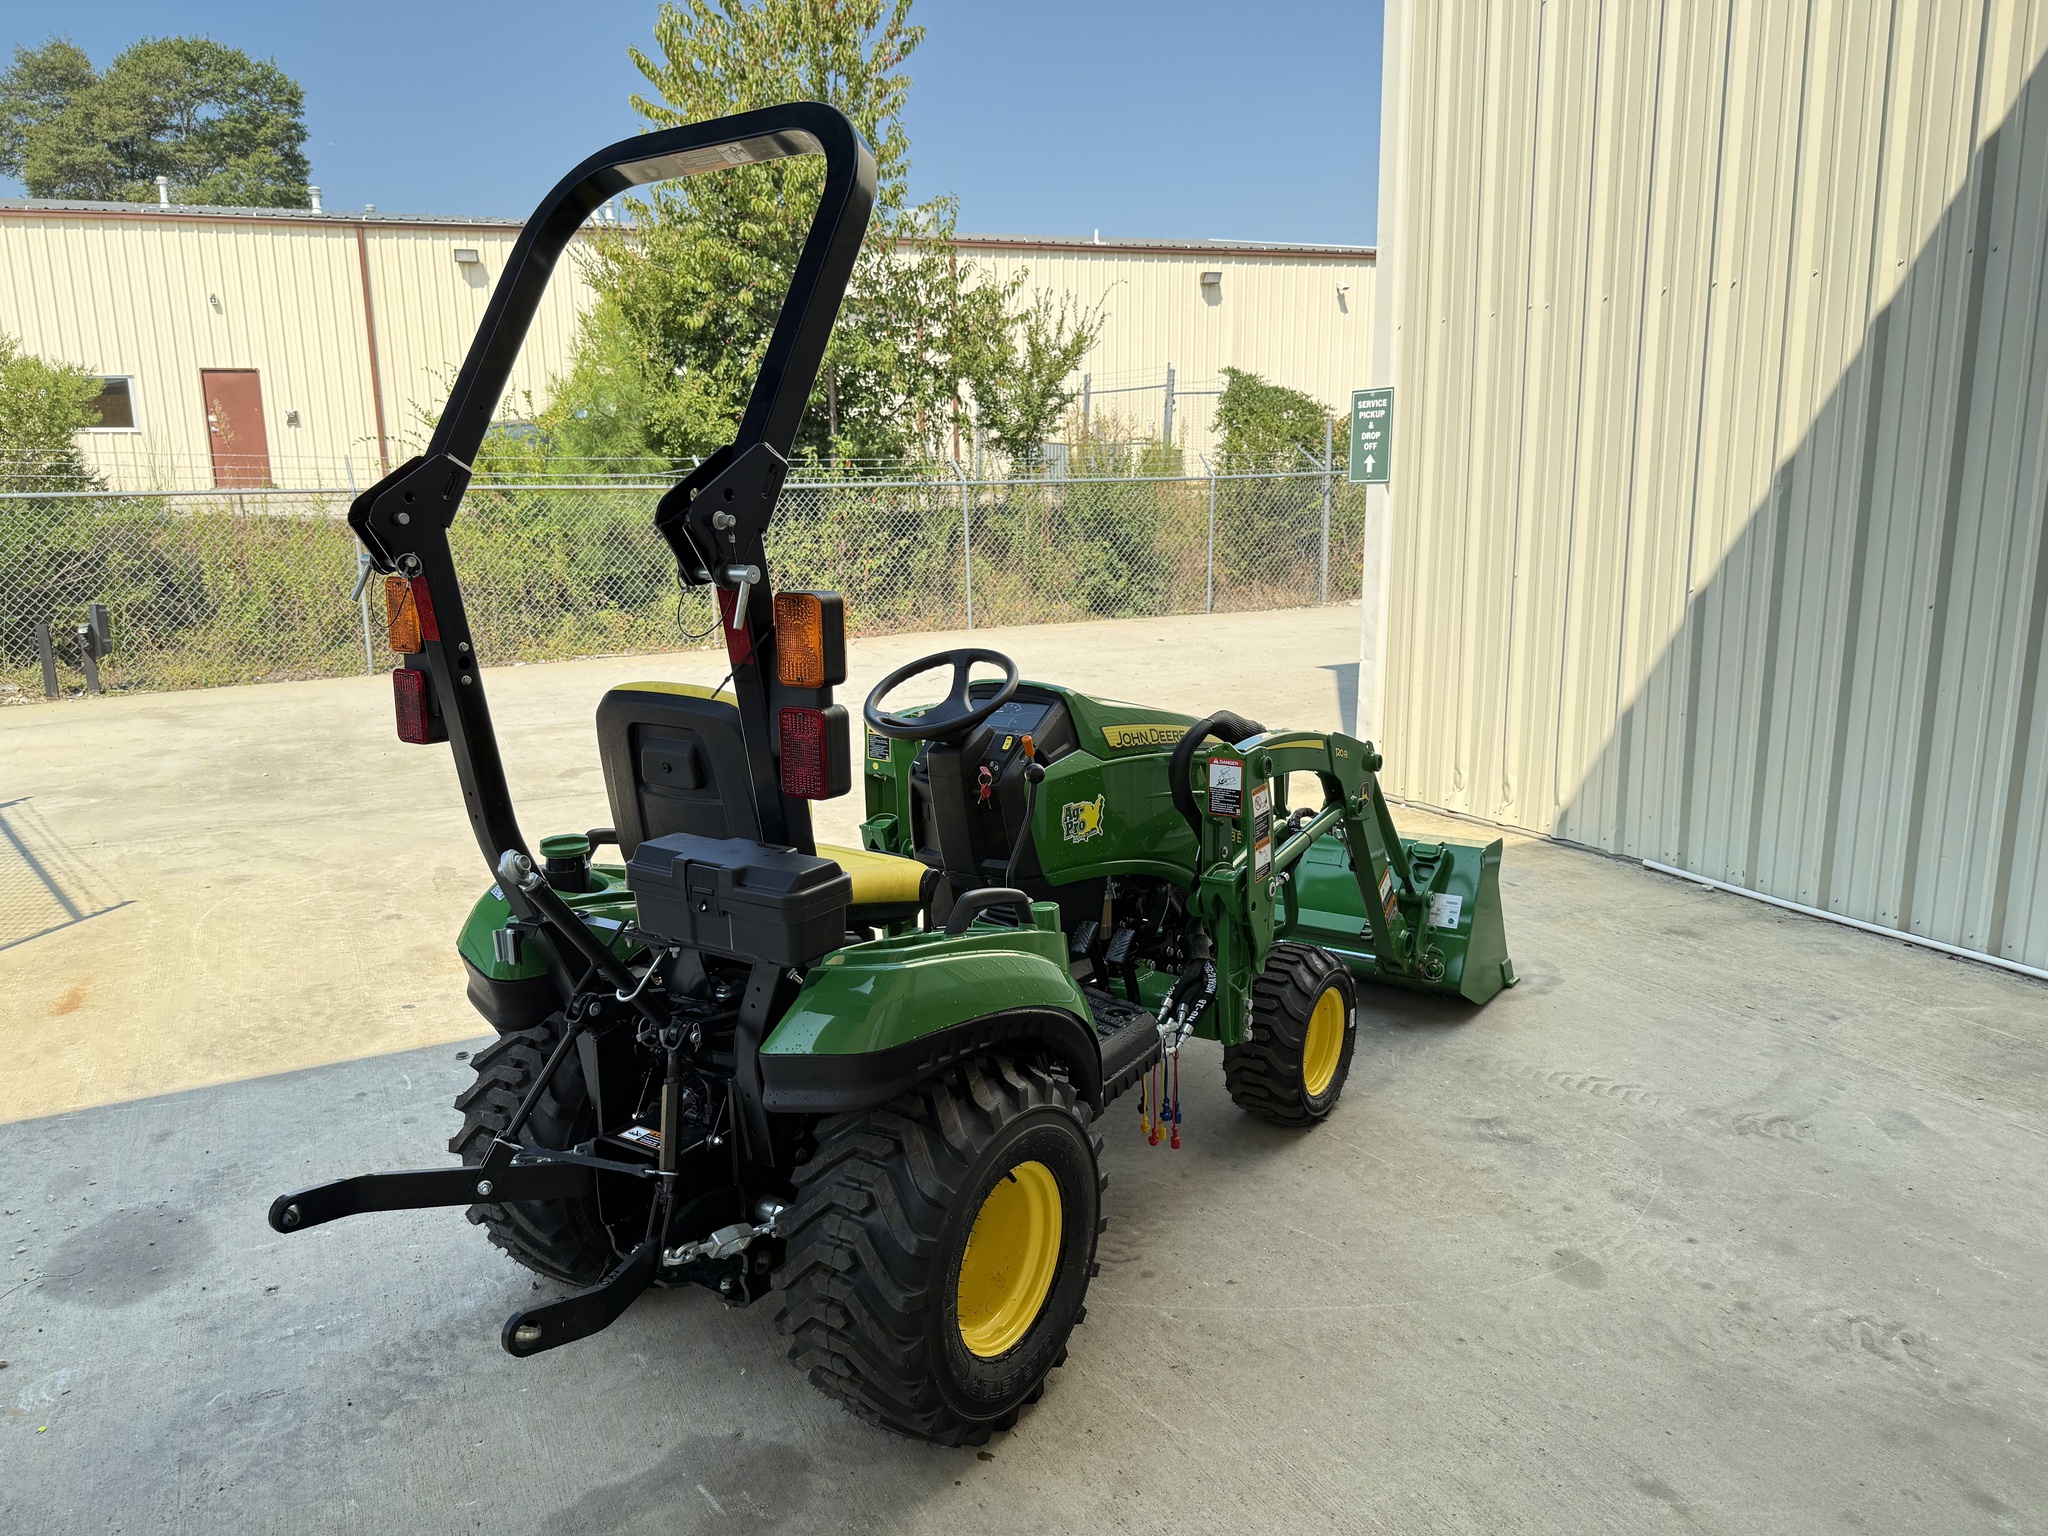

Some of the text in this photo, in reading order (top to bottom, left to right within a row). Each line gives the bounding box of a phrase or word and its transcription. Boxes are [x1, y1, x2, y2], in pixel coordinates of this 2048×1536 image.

[1357, 399, 1387, 409] SERVICE
[1359, 410, 1385, 419] PICKUP
[1368, 421, 1374, 429] &
[1361, 431, 1381, 440] DROP
[1363, 442, 1378, 450] OFF
[1116, 730, 1149, 746] JOHN
[1066, 820, 1086, 837] Pro
